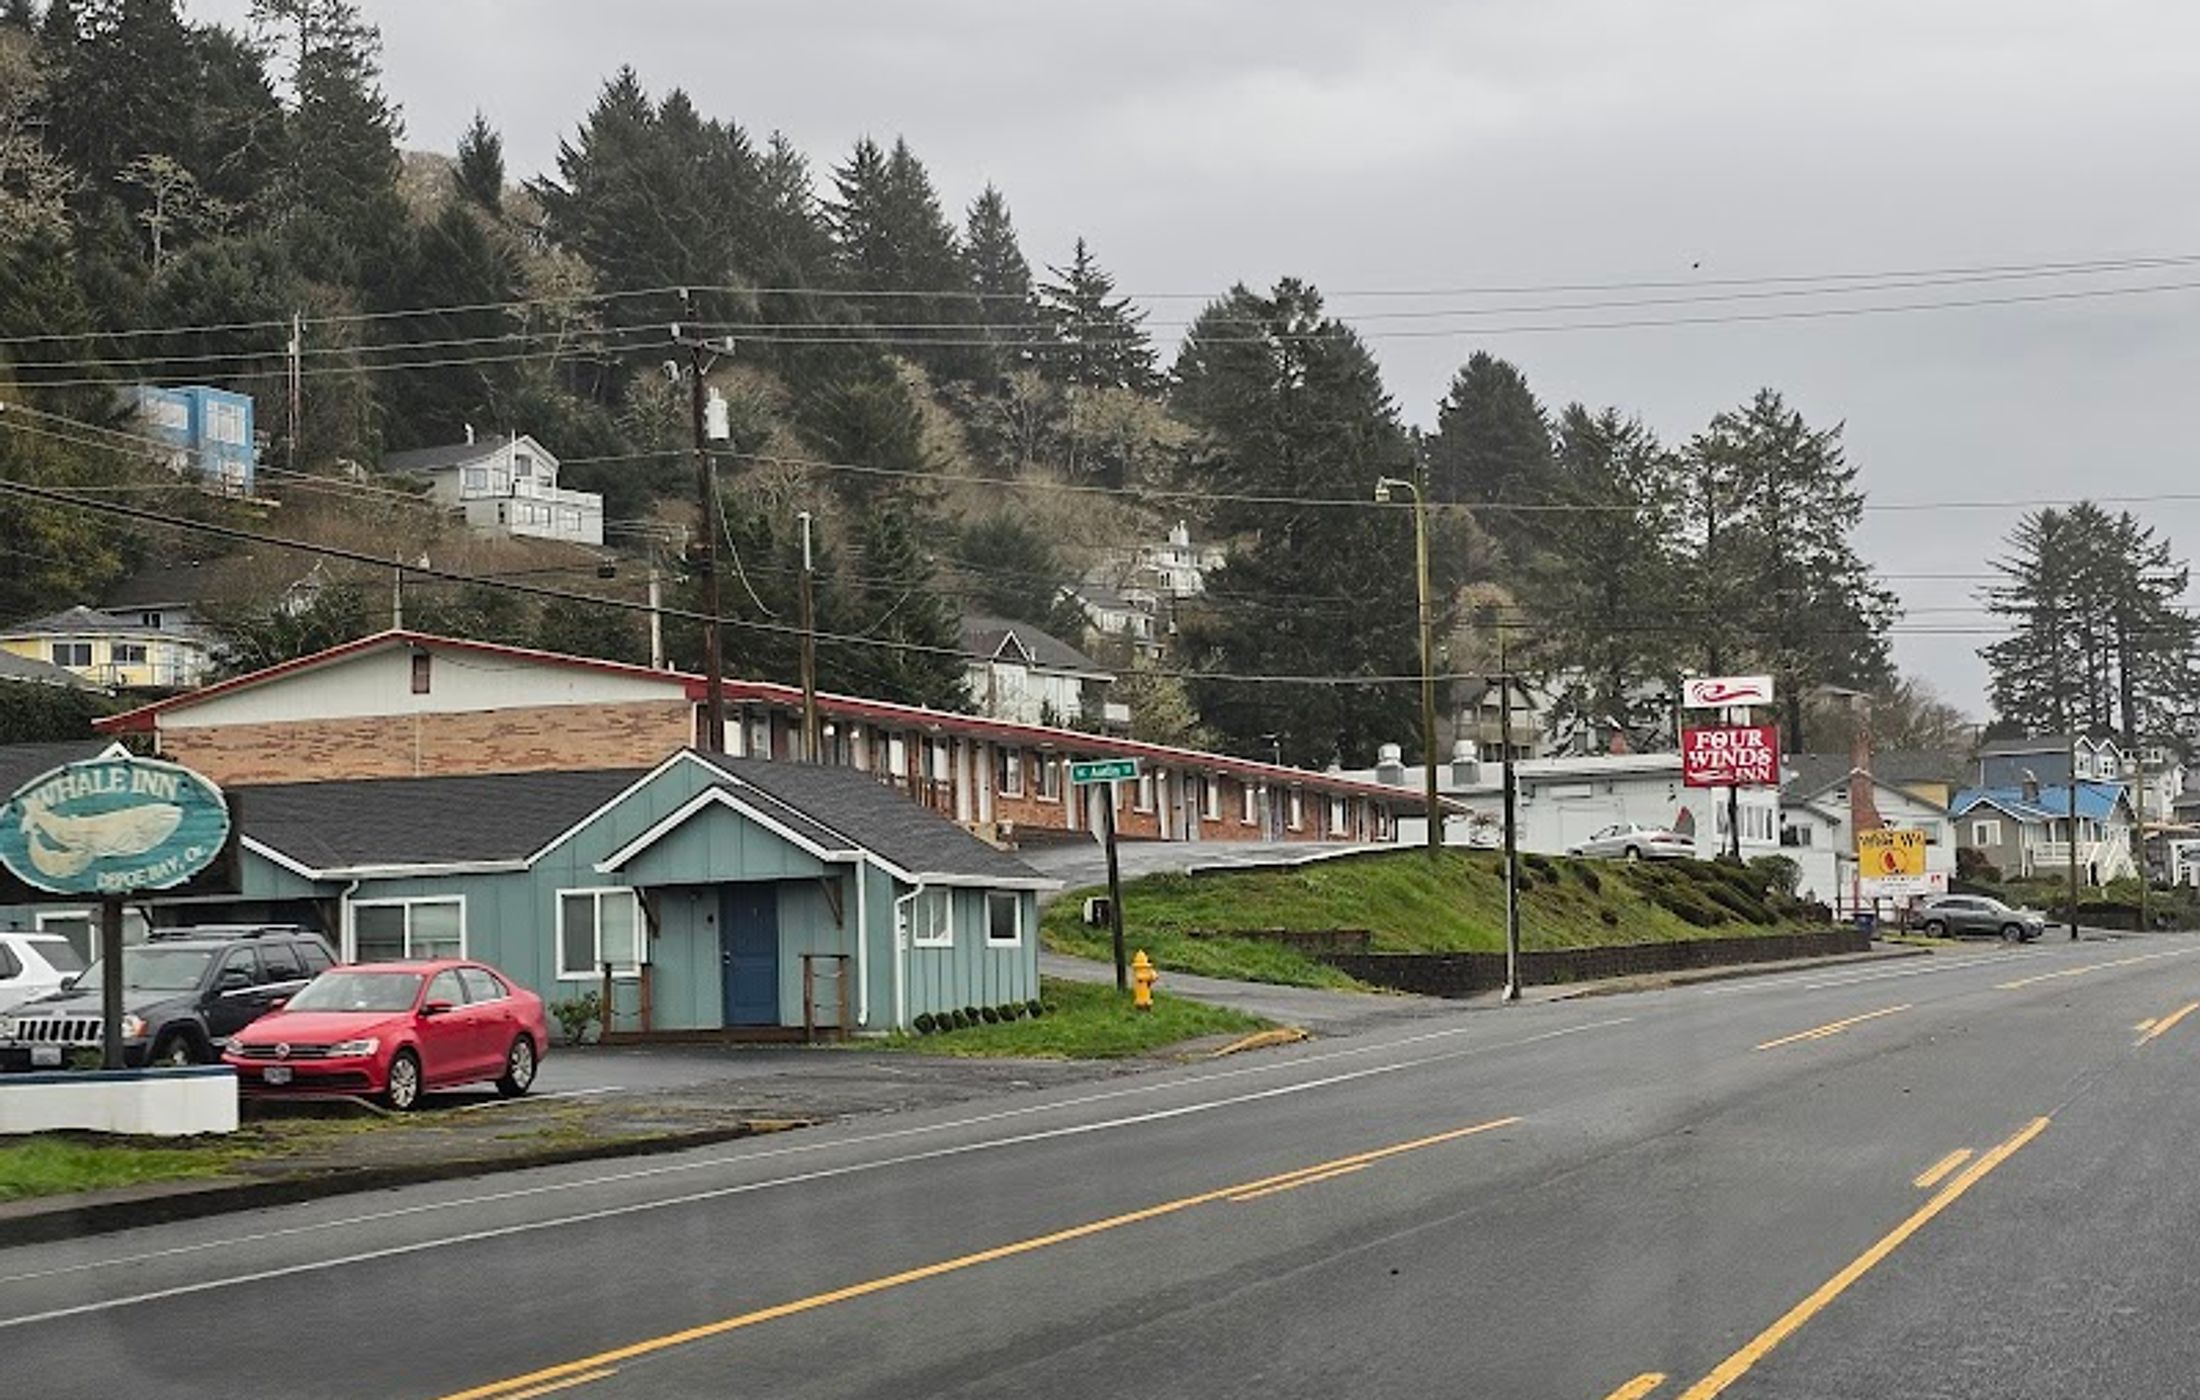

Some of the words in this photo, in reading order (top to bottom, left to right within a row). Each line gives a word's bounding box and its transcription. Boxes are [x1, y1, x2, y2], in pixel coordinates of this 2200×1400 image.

[1695, 729, 1763, 750] FOUR
[1689, 748, 1772, 768] WINDS
[1735, 767, 1770, 782] INN
[27, 768, 129, 808] WHALE
[132, 770, 180, 800] INN
